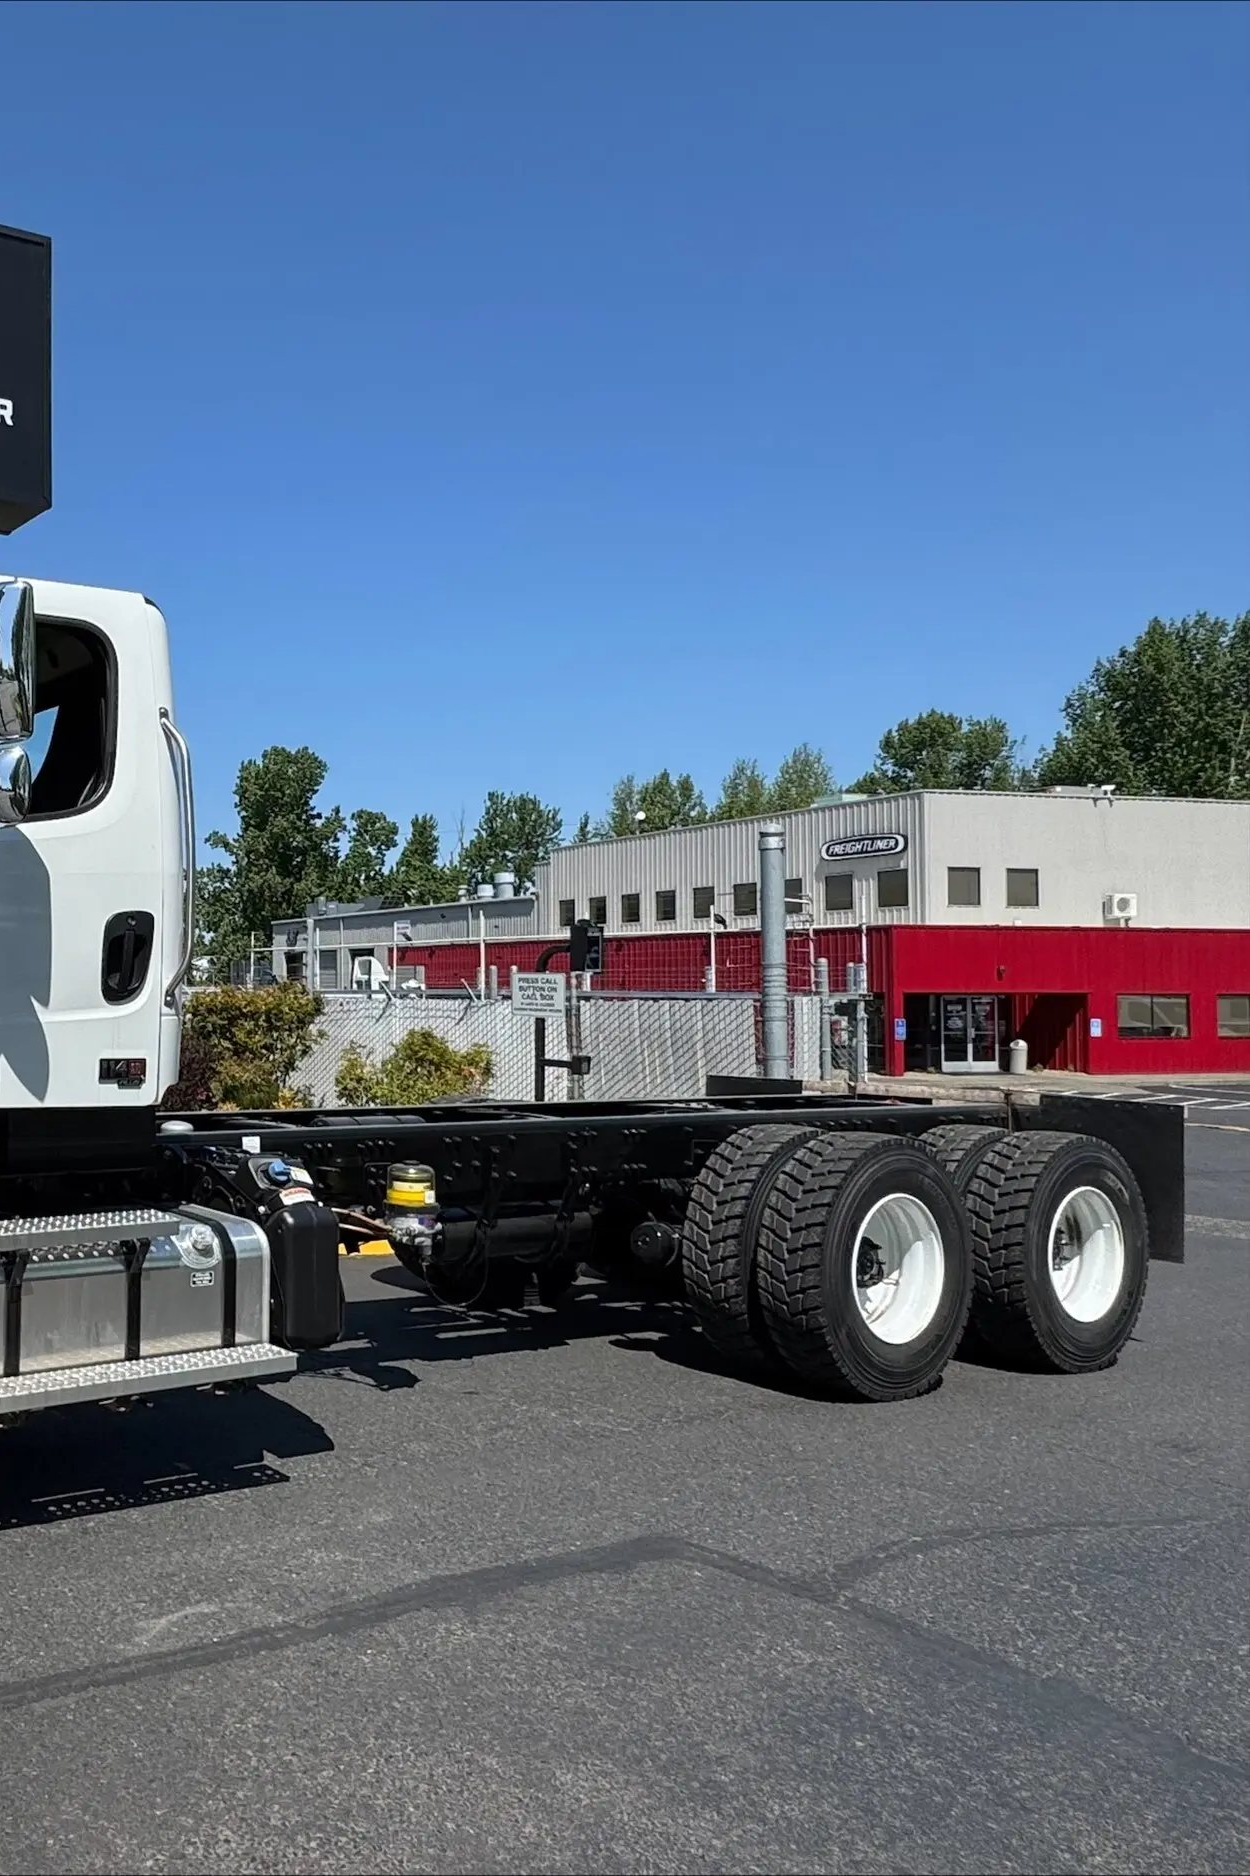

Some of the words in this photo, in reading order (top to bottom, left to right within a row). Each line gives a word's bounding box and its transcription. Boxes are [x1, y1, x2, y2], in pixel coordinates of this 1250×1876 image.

[828, 838, 897, 856] FREIGHTLINER
[518, 977, 539, 985] PRESS
[540, 977, 559, 985] CALL
[518, 985, 546, 993] BUTTON
